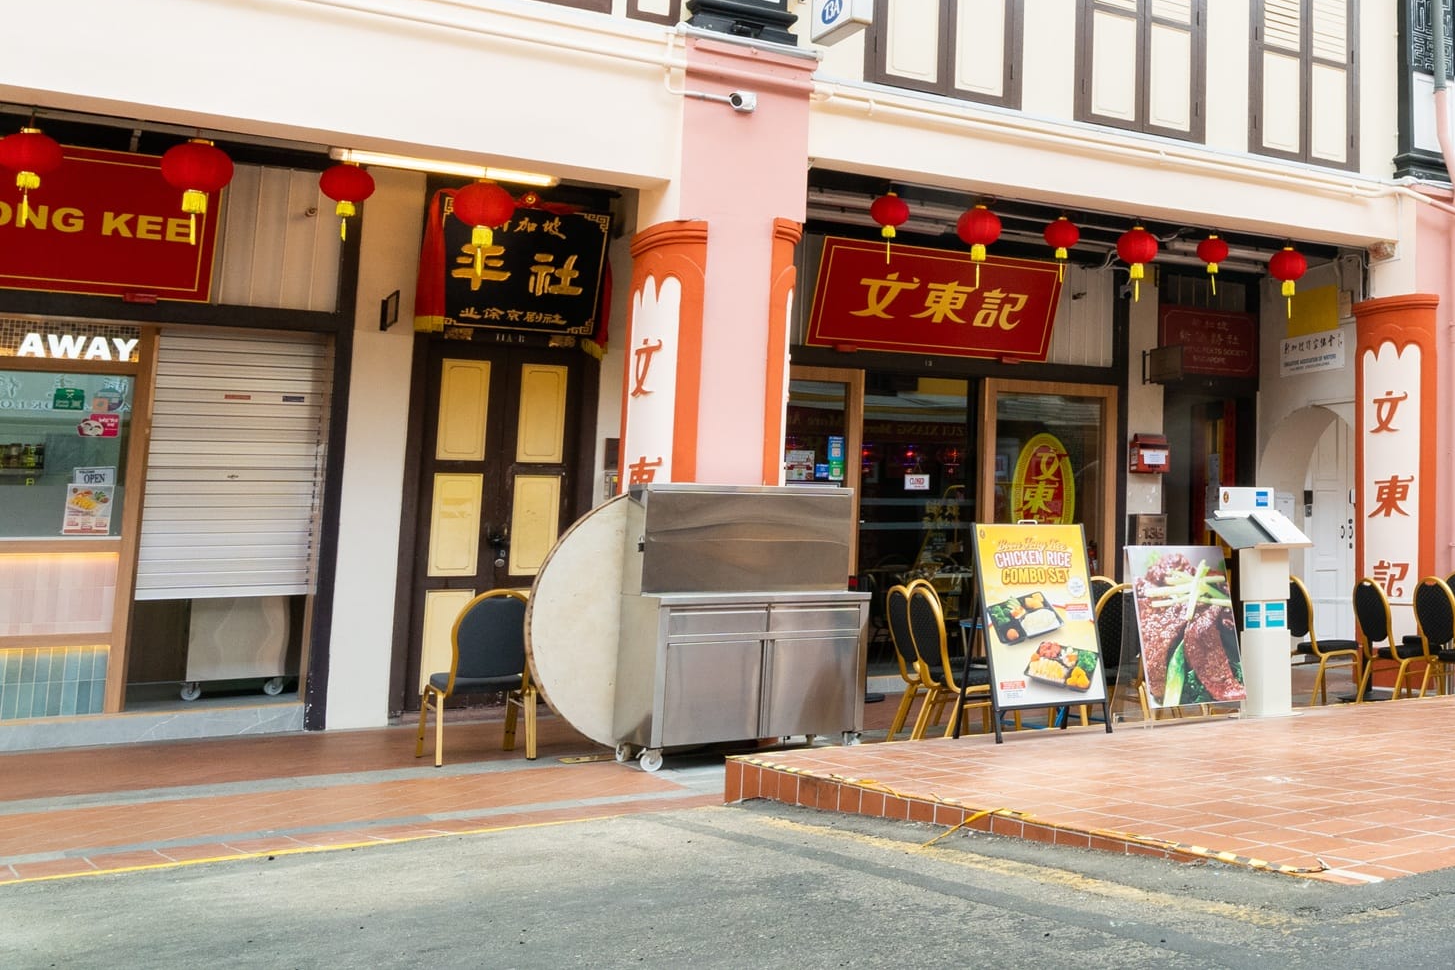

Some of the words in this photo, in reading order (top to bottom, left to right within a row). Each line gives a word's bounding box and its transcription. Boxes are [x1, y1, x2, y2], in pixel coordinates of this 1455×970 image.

[849, 271, 1029, 330] 文東記
[17, 332, 139, 362] AWAY
[83, 473, 106, 484] OPEN
[1368, 390, 1414, 598] 文東記
[995, 550, 1044, 568] CHICKEN
[1046, 550, 1072, 568] RICE
[1001, 567, 1046, 584] COMBO
[1047, 567, 1070, 584] SET
